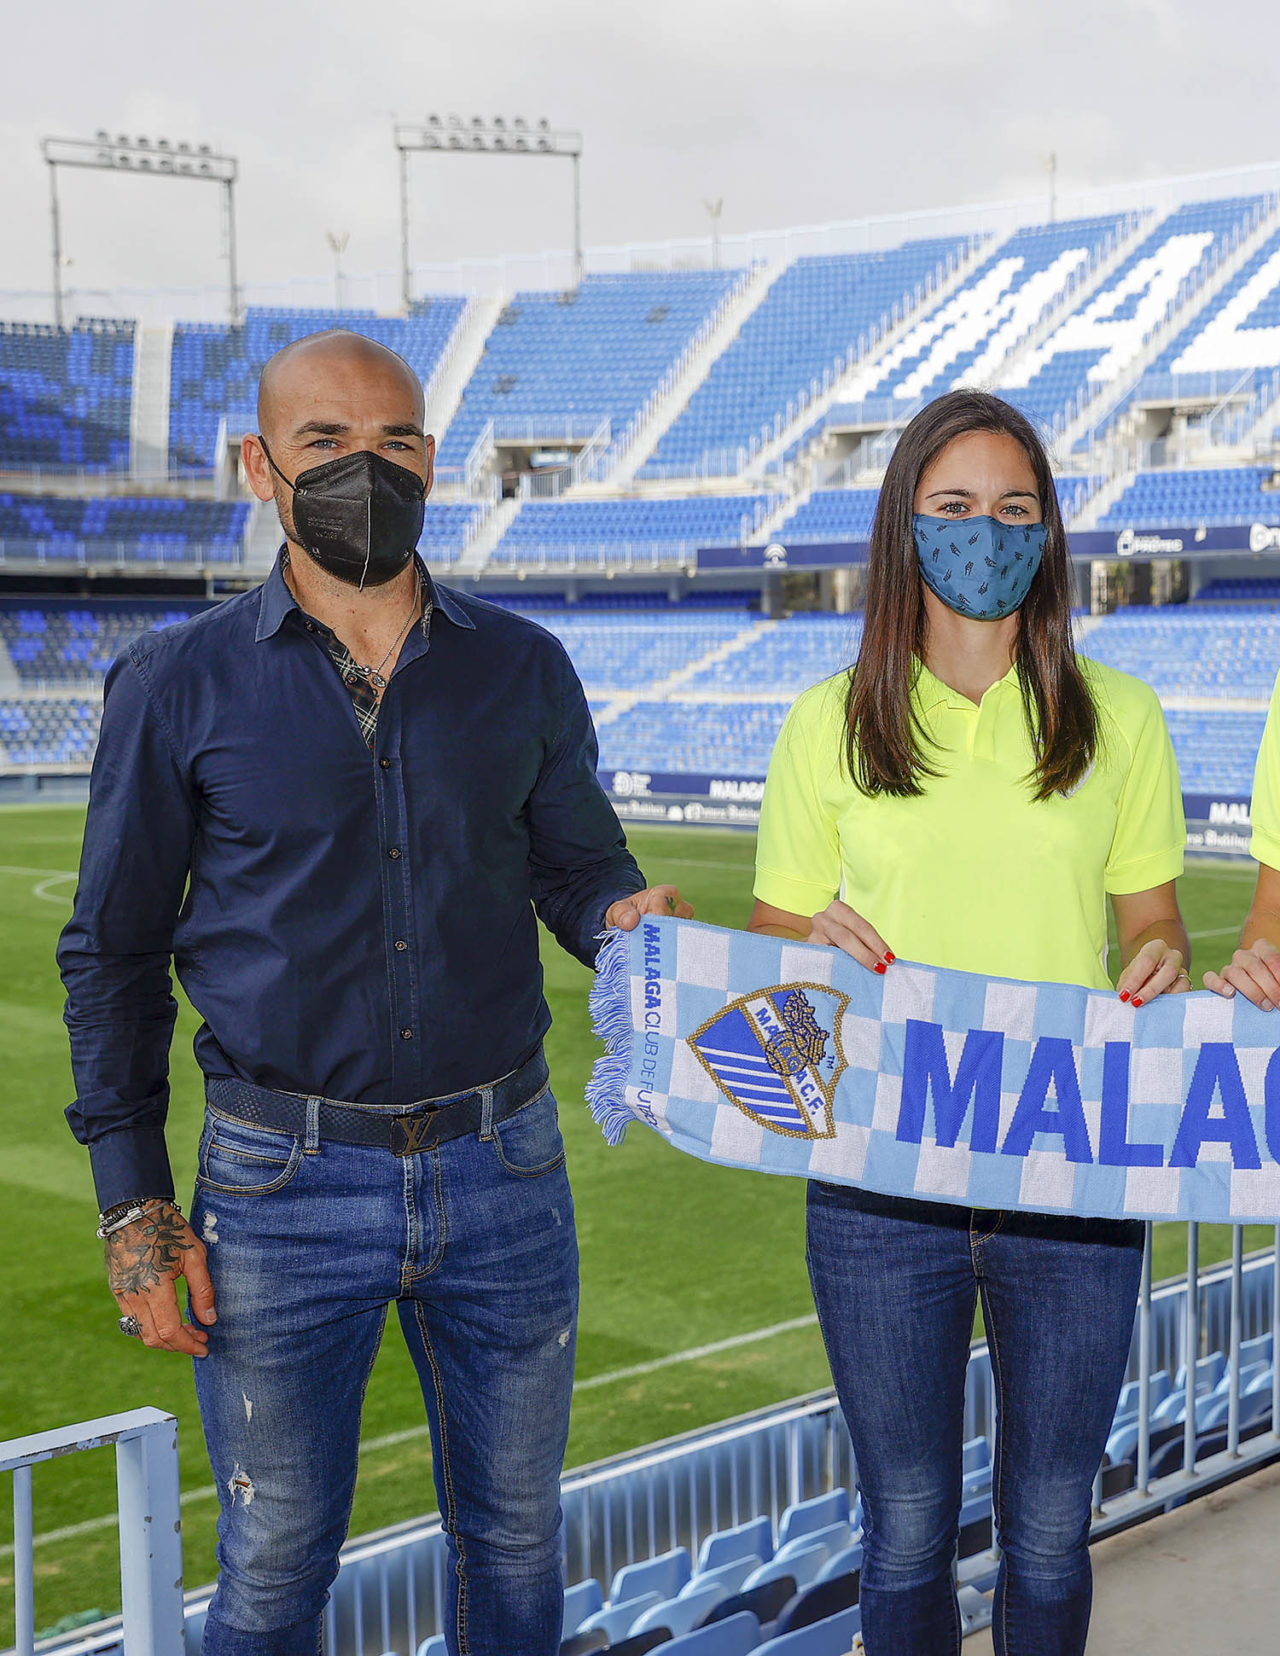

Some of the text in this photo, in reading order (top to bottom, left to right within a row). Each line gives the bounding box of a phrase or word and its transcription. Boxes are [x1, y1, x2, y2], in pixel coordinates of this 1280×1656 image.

[643, 923, 661, 1009] MALAGA
[644, 1011, 661, 1056] CLUB
[640, 1059, 657, 1078] DE
